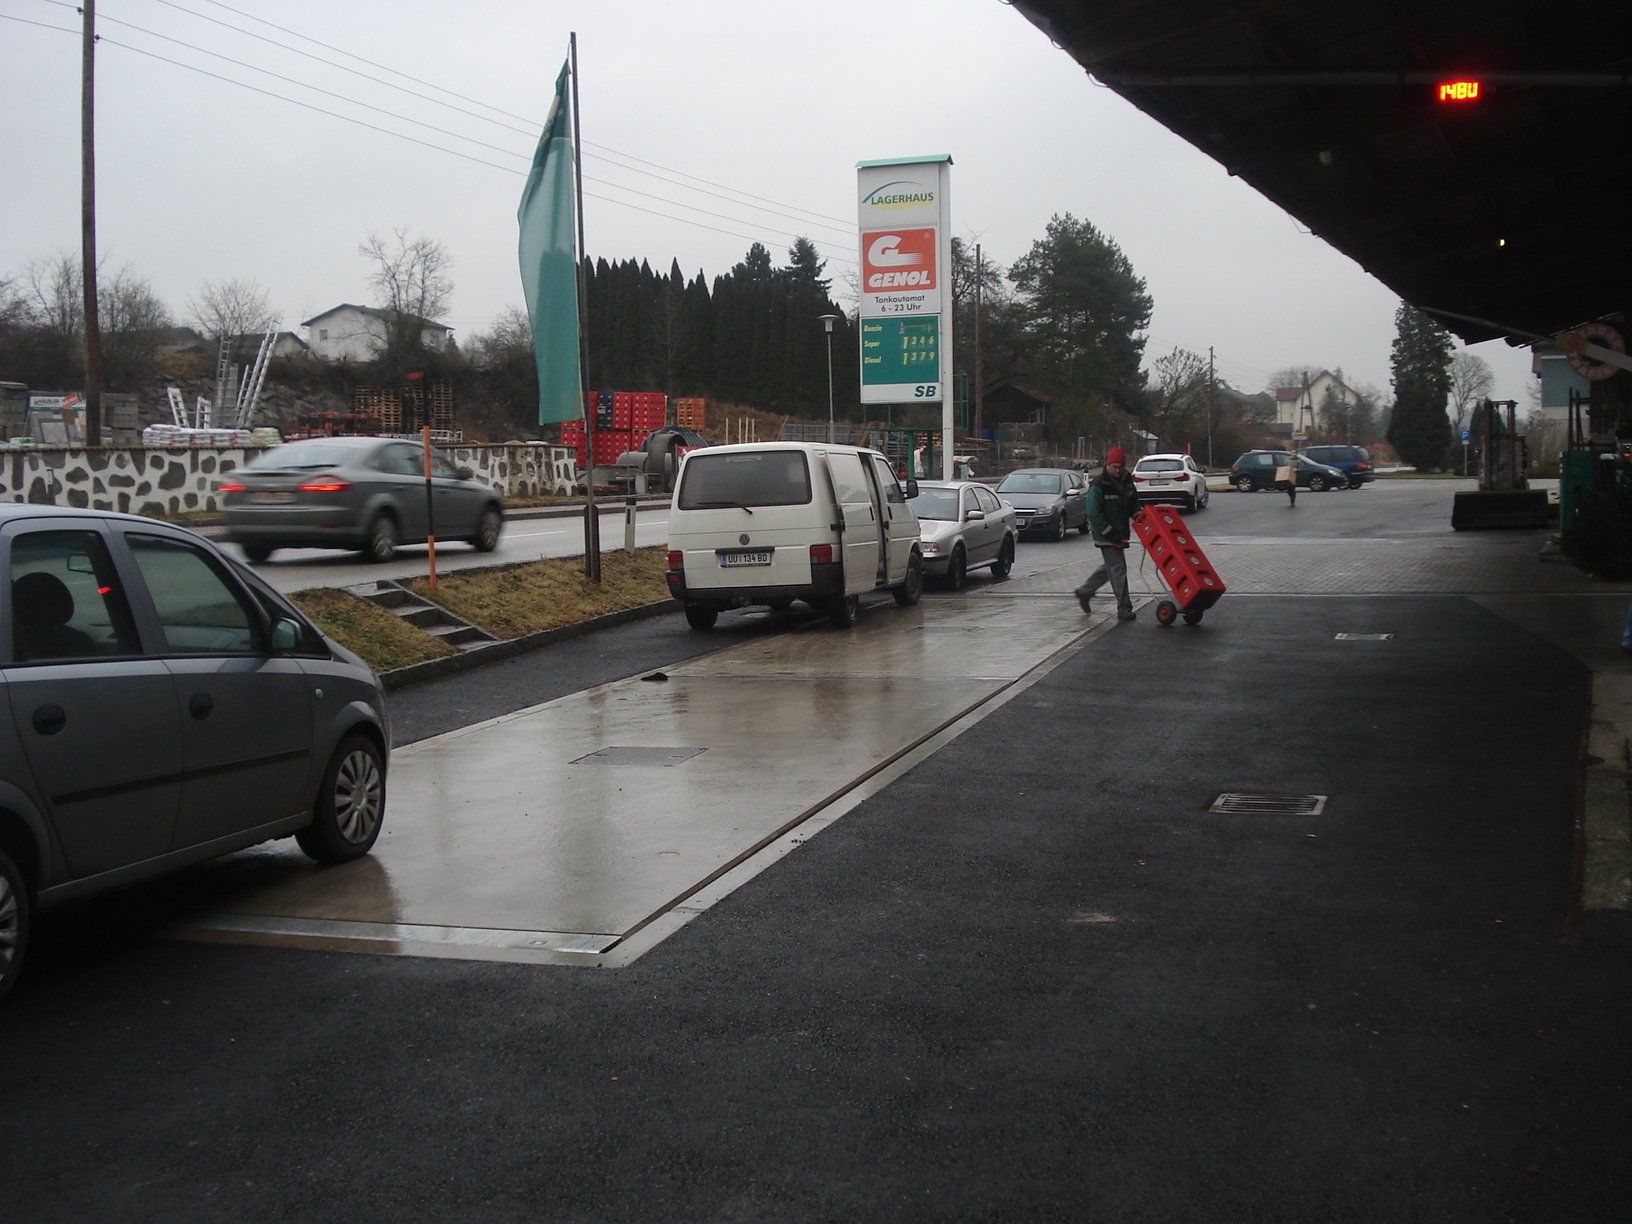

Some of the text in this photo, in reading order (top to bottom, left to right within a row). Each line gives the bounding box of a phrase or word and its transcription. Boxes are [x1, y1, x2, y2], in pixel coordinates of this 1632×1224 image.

[871, 192, 934, 205] LAGERHAUS
[868, 270, 931, 288] GENOL
[875, 294, 925, 304] Tankautomat
[894, 304, 904, 312] 23
[906, 303, 922, 311] Uhr
[864, 340, 880, 348] Super
[864, 356, 881, 364] Diesel
[914, 385, 937, 398] SB
[728, 553, 768, 563] UU 134 BD
